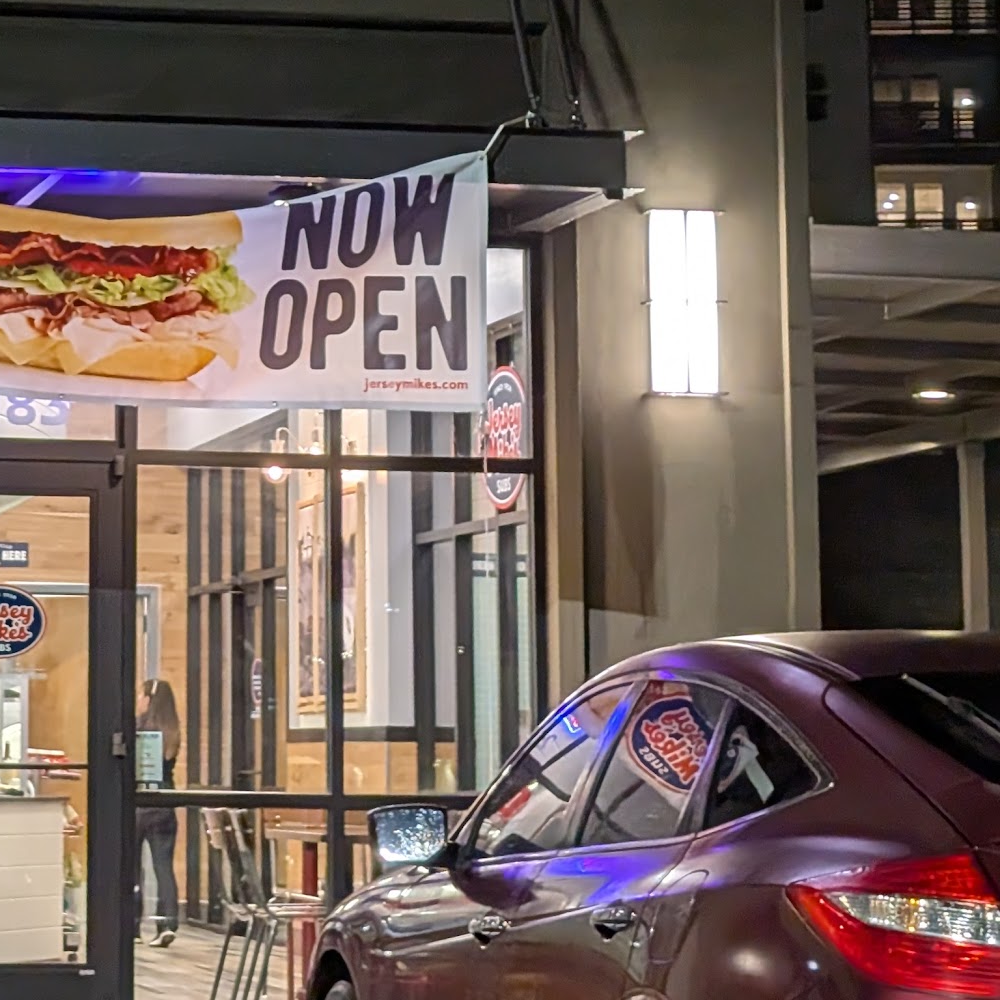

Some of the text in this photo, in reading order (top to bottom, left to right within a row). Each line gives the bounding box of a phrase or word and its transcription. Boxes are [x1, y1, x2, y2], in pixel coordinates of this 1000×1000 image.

[281, 173, 456, 271] NOW
[259, 275, 468, 371] OPEN
[364, 377, 469, 393] jerseymikes.com
[1, 550, 27, 561] HERE
